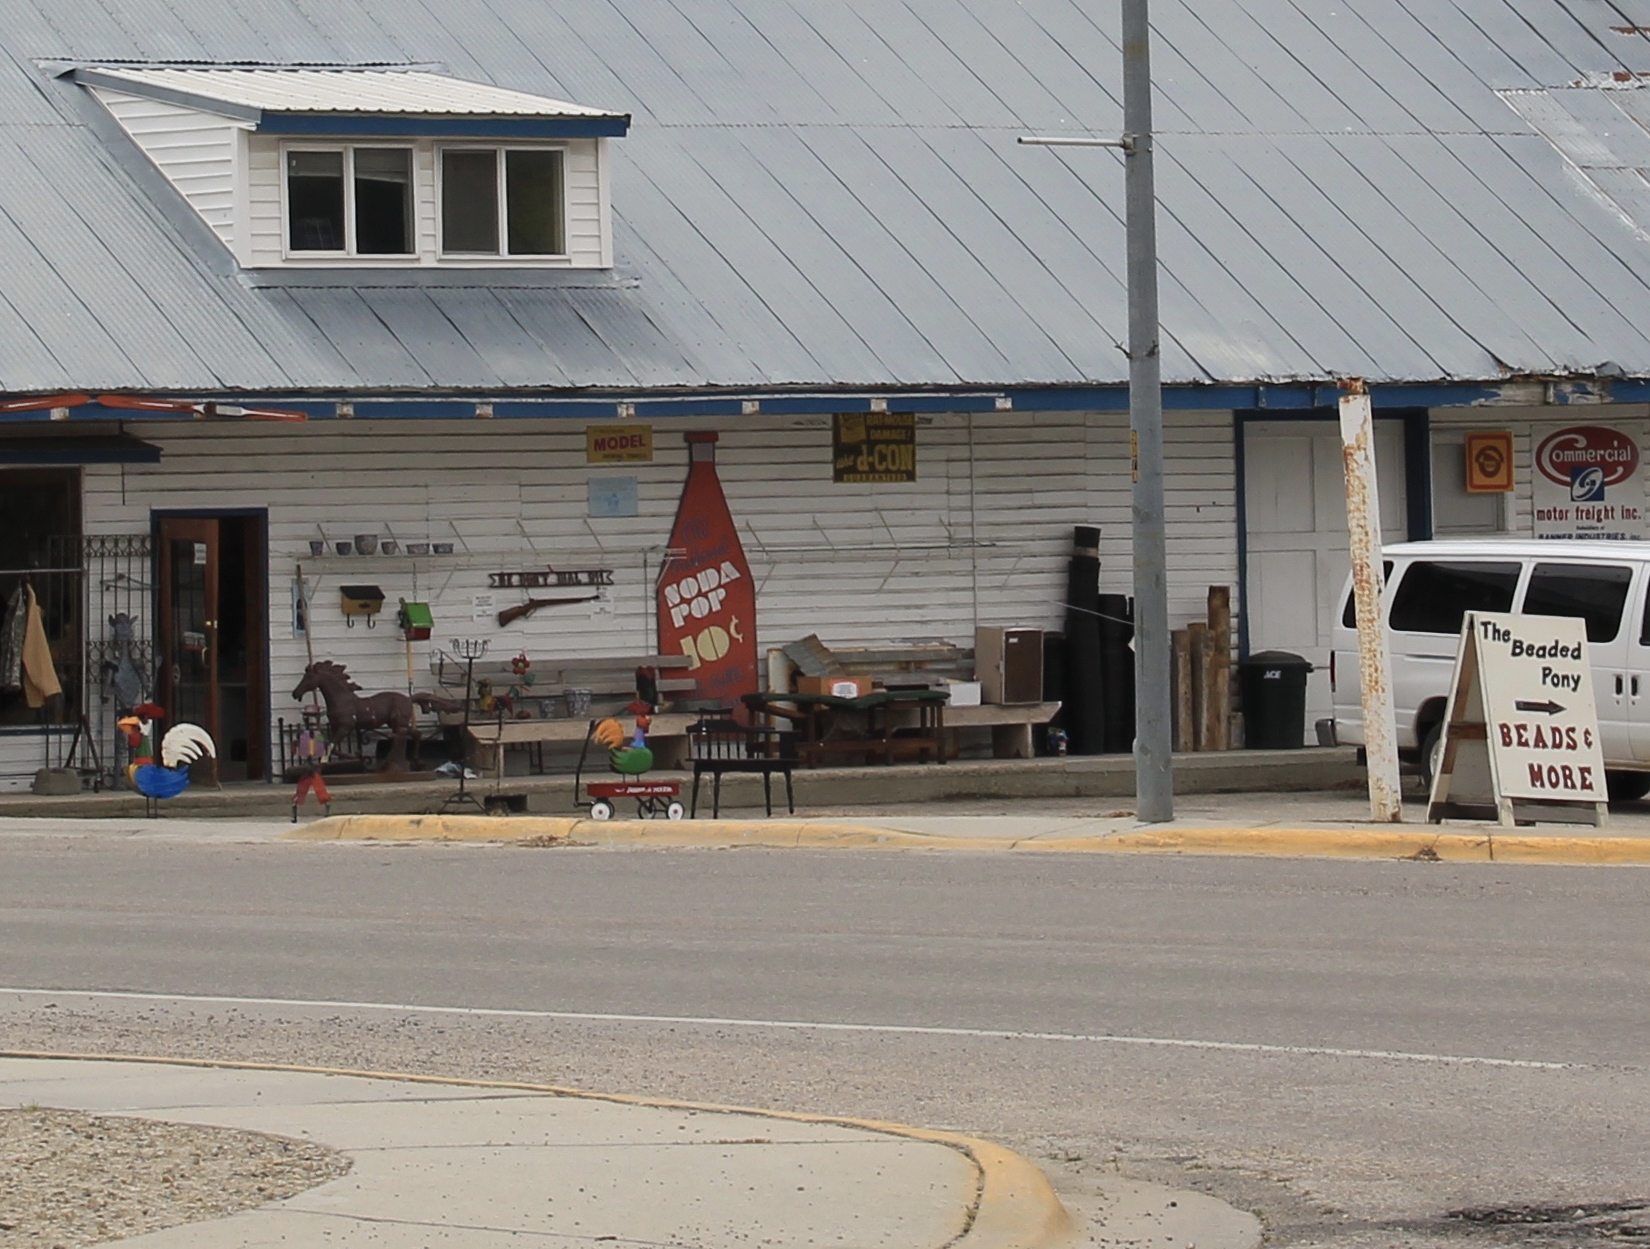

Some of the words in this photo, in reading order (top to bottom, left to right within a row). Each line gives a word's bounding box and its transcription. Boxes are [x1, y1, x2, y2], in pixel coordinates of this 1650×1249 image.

[594, 434, 647, 452] MODEL
[856, 444, 913, 471] d-CON
[1541, 434, 1632, 484] Commercial
[1536, 507, 1569, 521] motor
[1576, 505, 1615, 523] freight
[1621, 505, 1641, 520] inc.
[664, 561, 741, 607] SODA
[670, 588, 726, 628] POP
[1481, 621, 1511, 642] The
[1511, 639, 1581, 660] Beaded
[1542, 667, 1581, 692] Pony
[1499, 722, 1577, 750] BEADS
[1528, 762, 1594, 791] MORE
